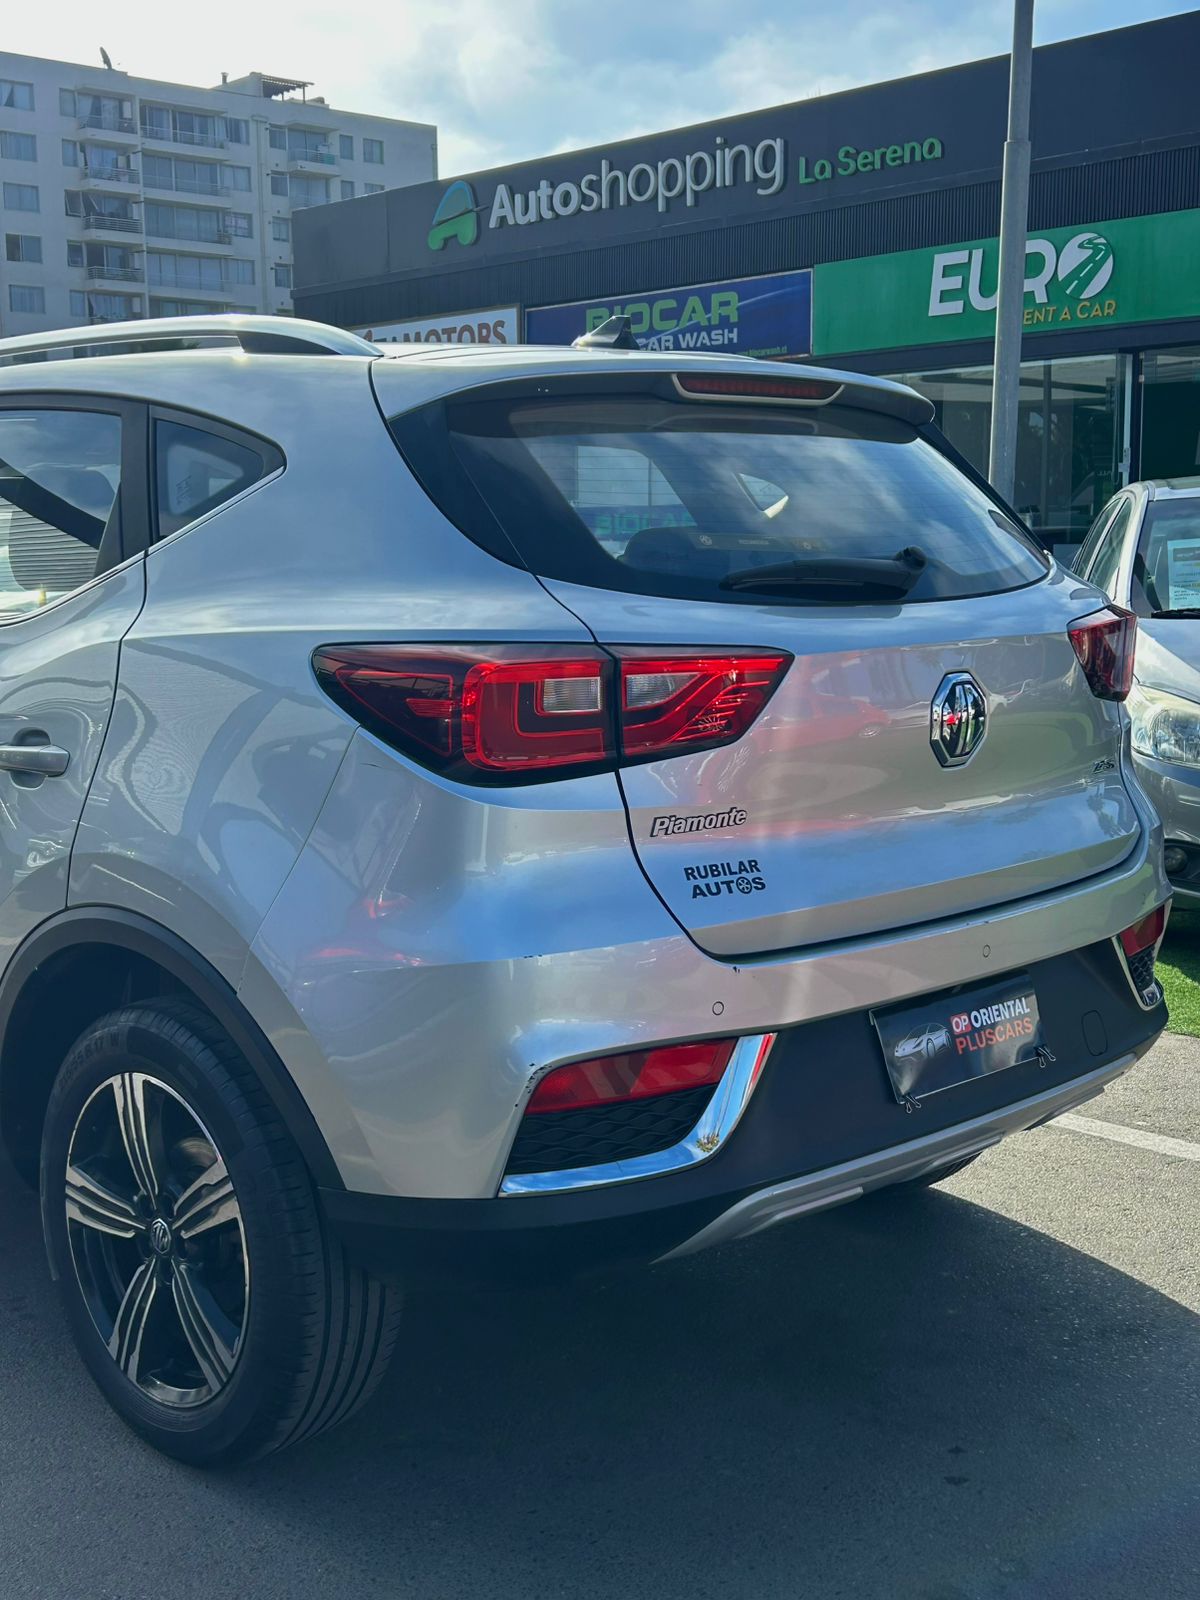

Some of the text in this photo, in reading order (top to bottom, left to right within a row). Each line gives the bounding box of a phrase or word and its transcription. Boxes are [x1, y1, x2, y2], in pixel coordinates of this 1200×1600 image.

[799, 137, 943, 185] La Serena
[488, 136, 785, 229] Autoshopping
[1023, 300, 1117, 325] ENT A CAR
[403, 320, 507, 343] TORS
[678, 328, 738, 349] WASH
[650, 807, 748, 837] Piamonte
[684, 860, 761, 880] RUBILAR
[692, 877, 766, 899] AUTOS
[952, 997, 1030, 1033] OP ORIENTAL
[955, 1017, 1034, 1055] PLUSCARS
